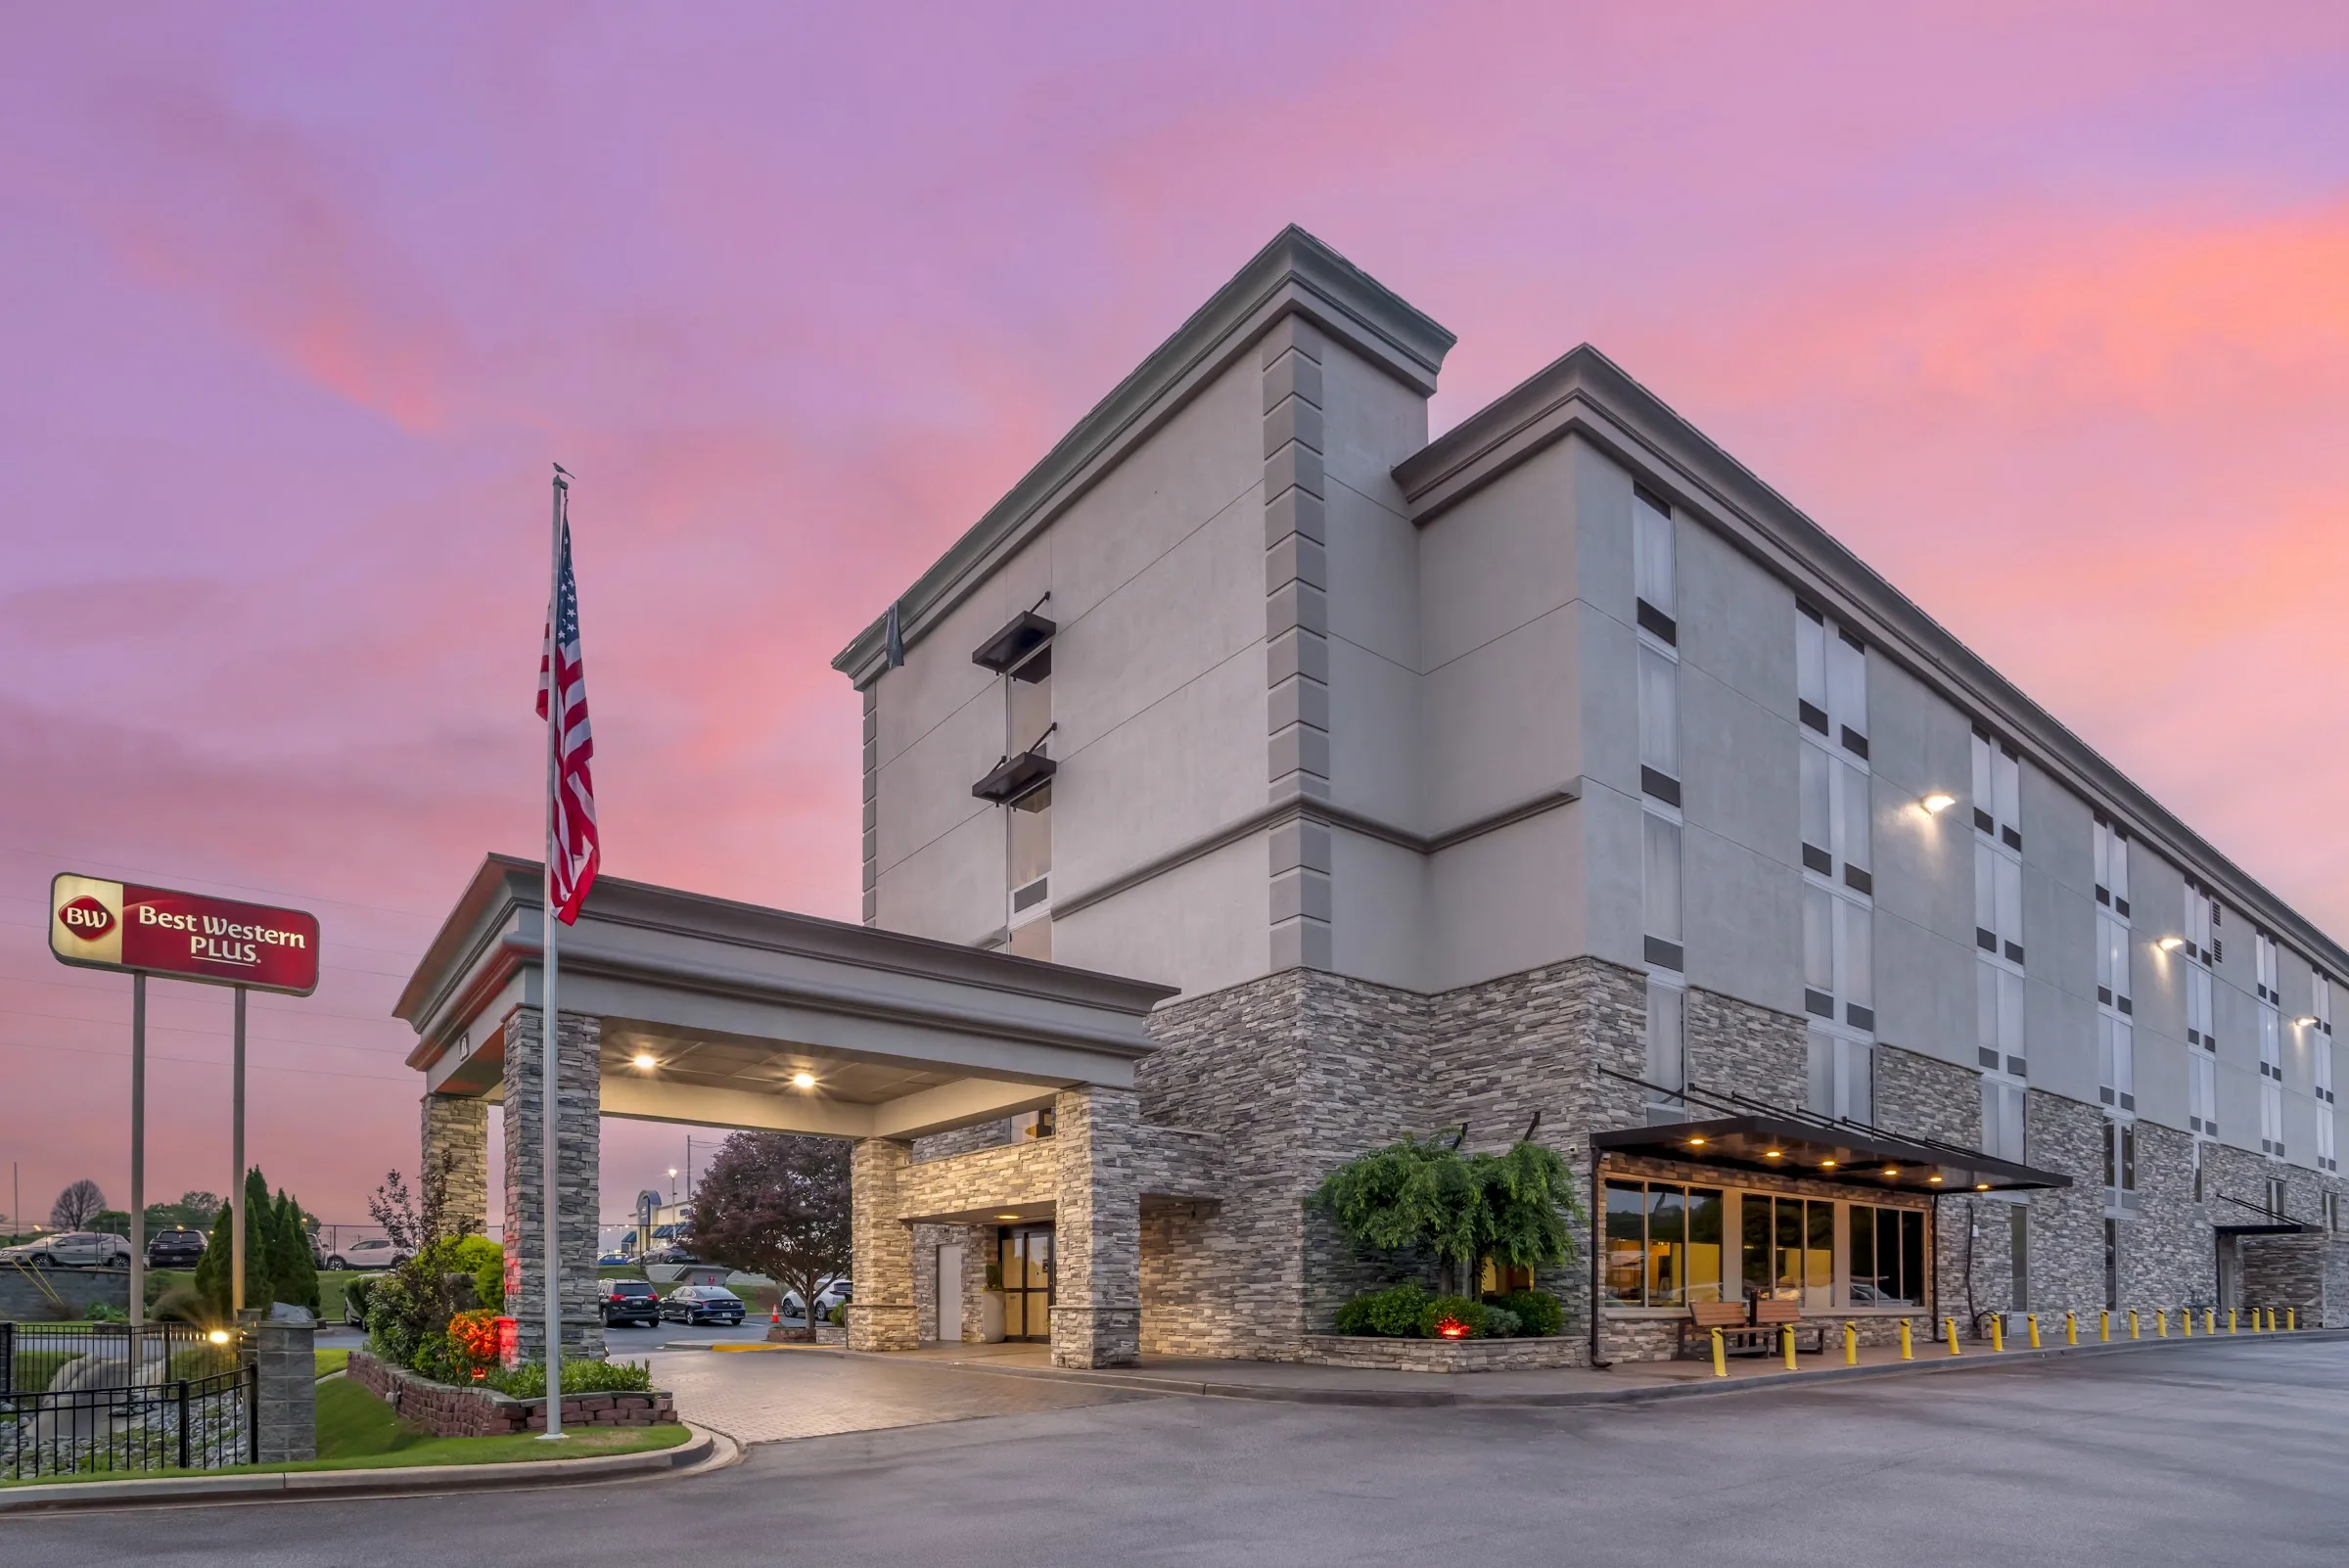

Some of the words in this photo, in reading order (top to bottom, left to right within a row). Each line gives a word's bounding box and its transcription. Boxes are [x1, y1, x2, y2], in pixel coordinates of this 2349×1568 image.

[67, 906, 108, 928] BW
[139, 905, 198, 933] Best
[203, 916, 305, 948] Western
